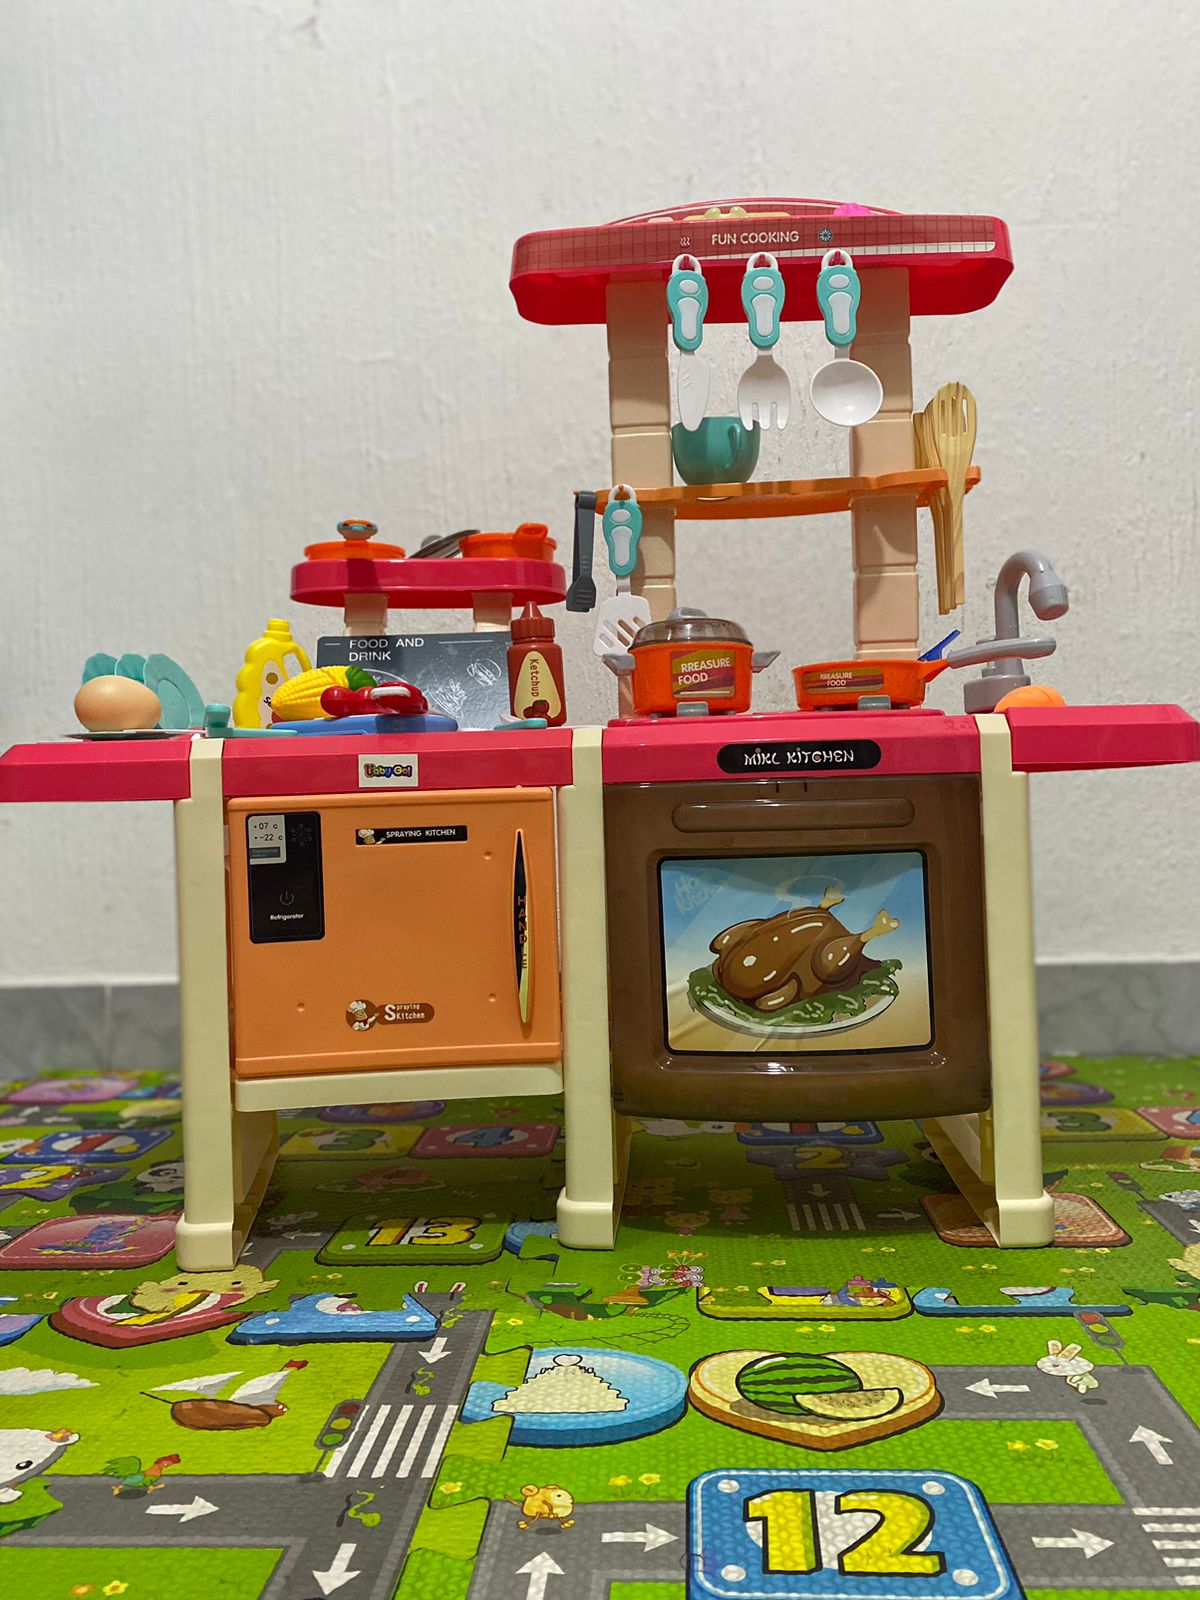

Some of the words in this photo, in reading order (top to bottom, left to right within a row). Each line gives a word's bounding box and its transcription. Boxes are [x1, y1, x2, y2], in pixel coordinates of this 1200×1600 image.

[711, 233, 737, 245] FUN
[740, 230, 800, 244] COOKING
[349, 638, 389, 649] FOOD
[395, 637, 425, 648] AND
[348, 650, 392, 662] DRINK
[680, 657, 731, 673] RREASURE
[529, 658, 541, 698] Ketchup
[678, 672, 708, 685] FOOD
[826, 679, 847, 687] FOOD
[386, 830, 423, 839] SPRAYING
[425, 828, 456, 837] KITCHEN
[269, 913, 305, 922] Refrigerator
[364, 1216, 482, 1247] 13
[743, 1488, 948, 1577] 12
